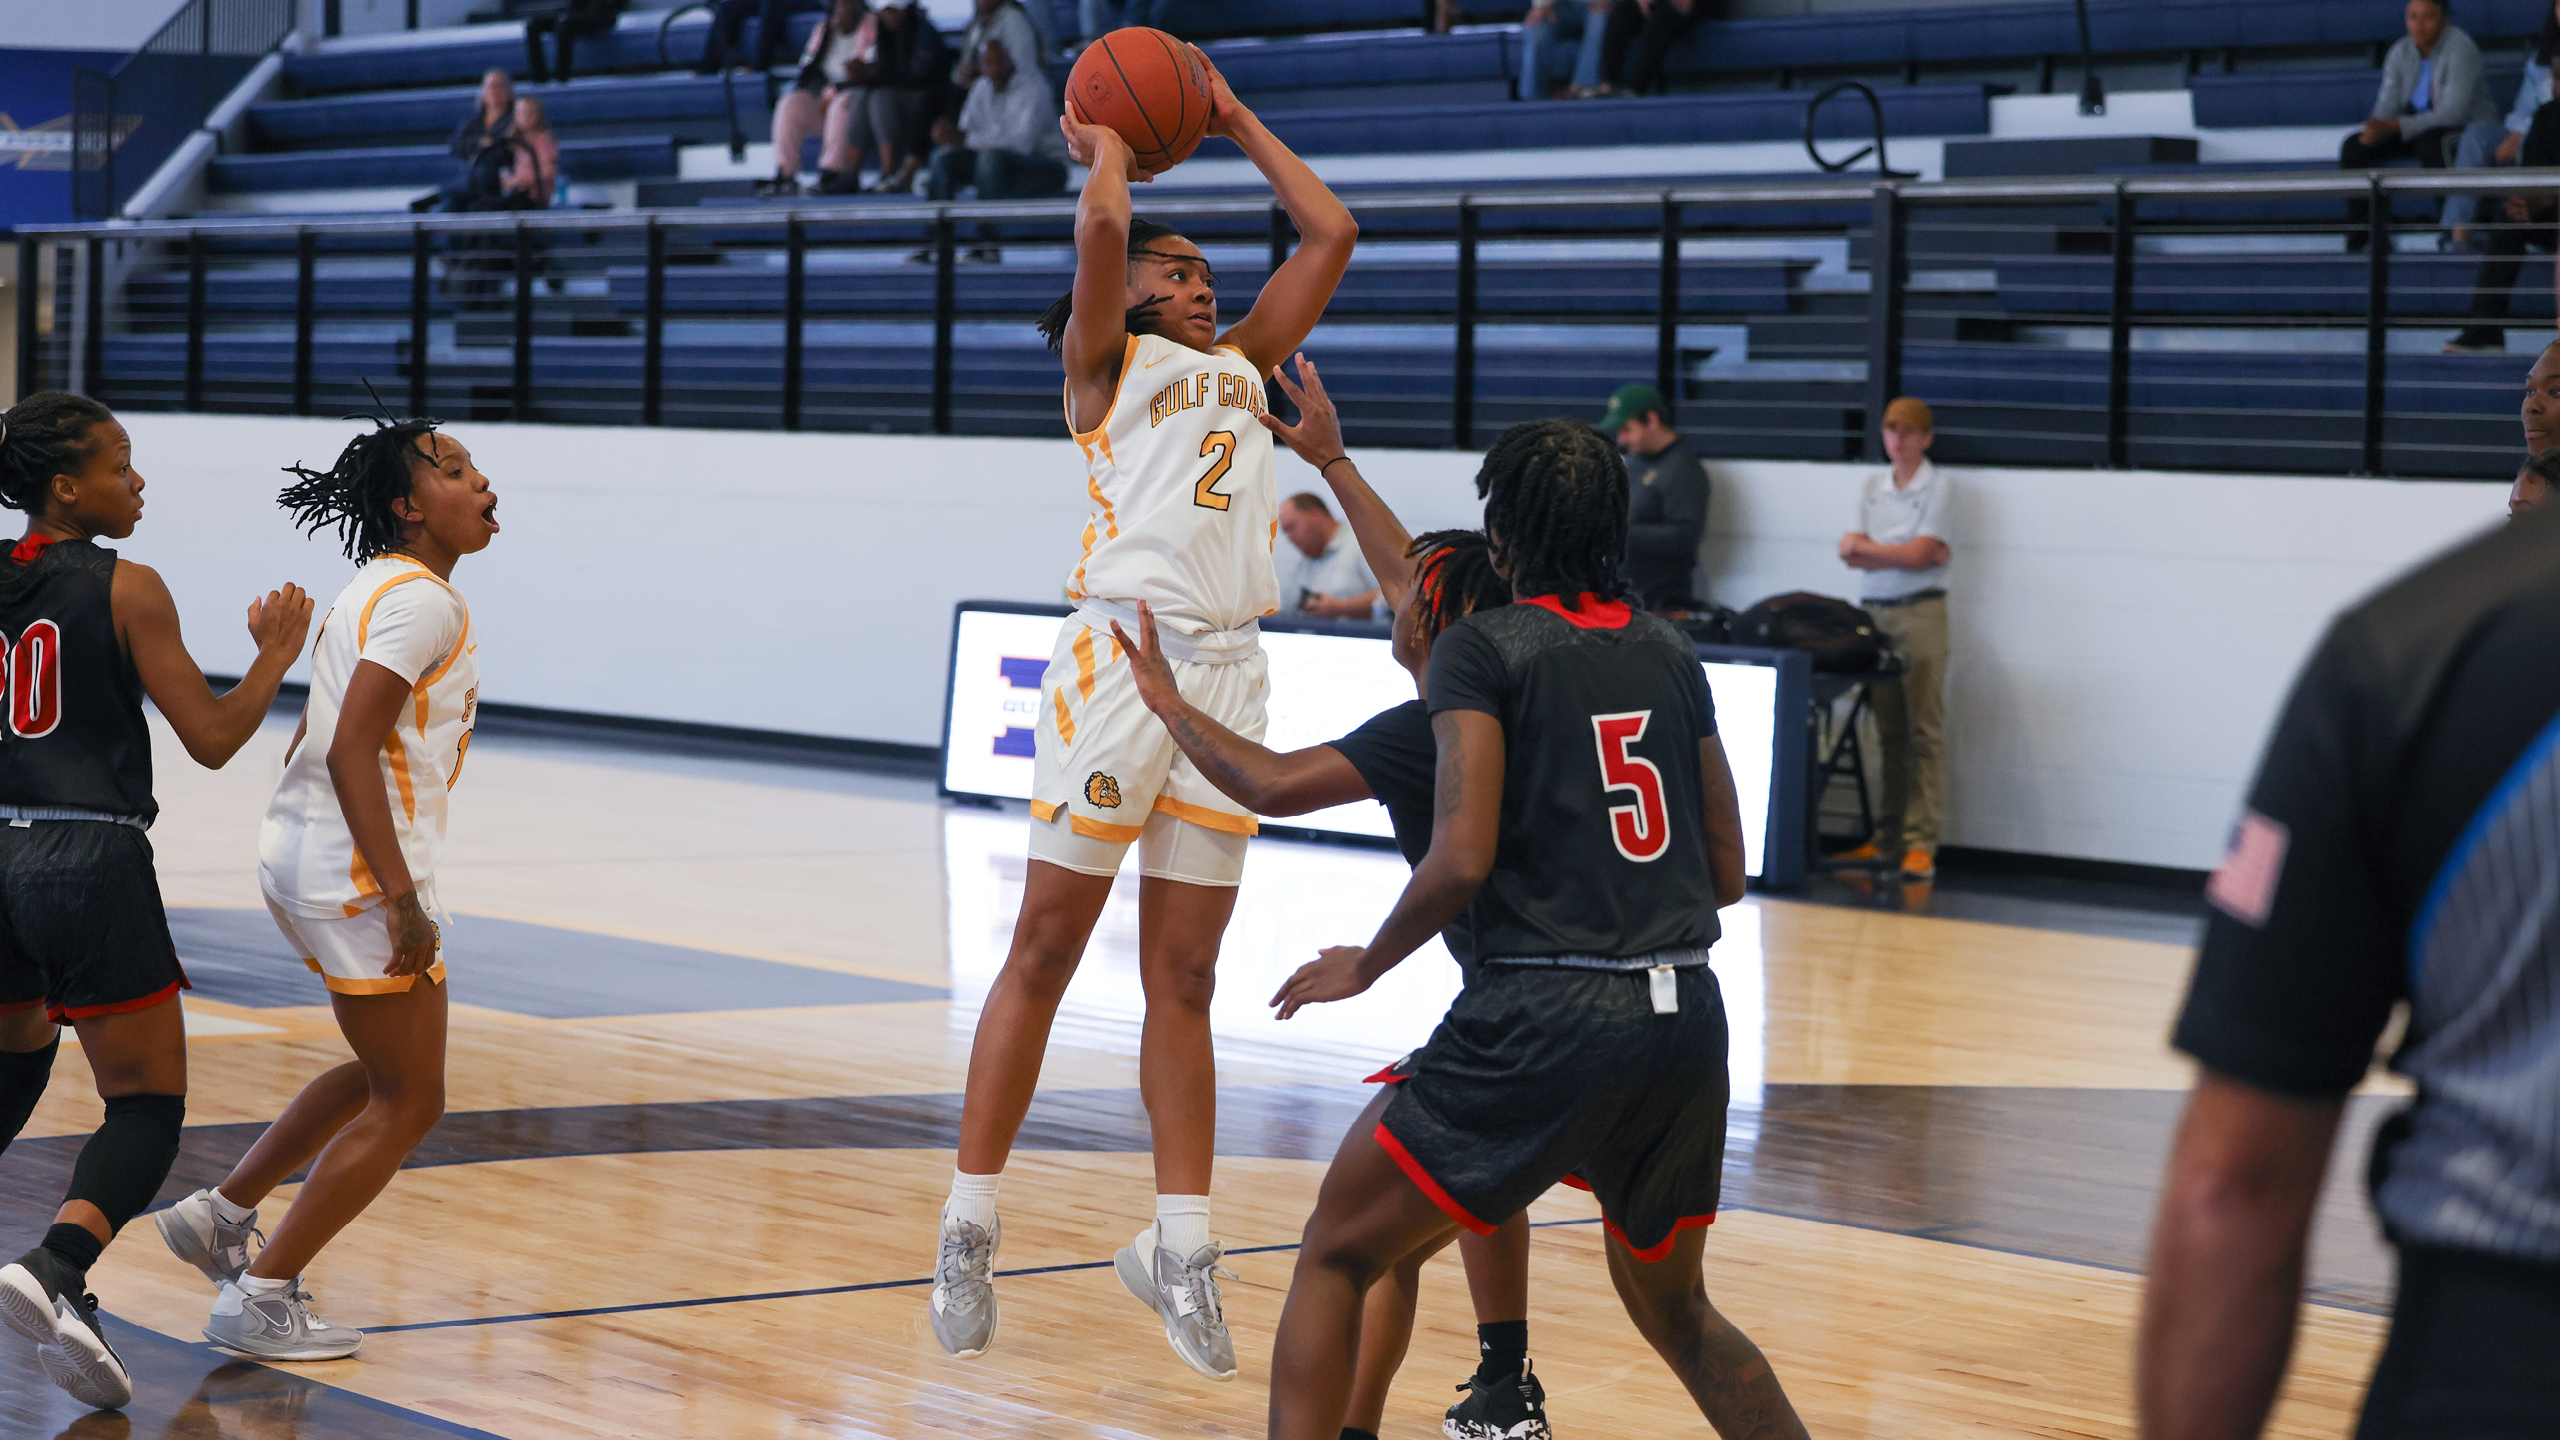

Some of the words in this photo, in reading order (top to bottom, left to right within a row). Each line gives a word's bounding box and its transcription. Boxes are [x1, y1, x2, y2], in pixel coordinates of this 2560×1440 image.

[1150, 373, 1209, 428] GULF
[1194, 430, 1236, 511] 2
[0, 618, 61, 739] 0
[1591, 710, 1670, 862] 5
